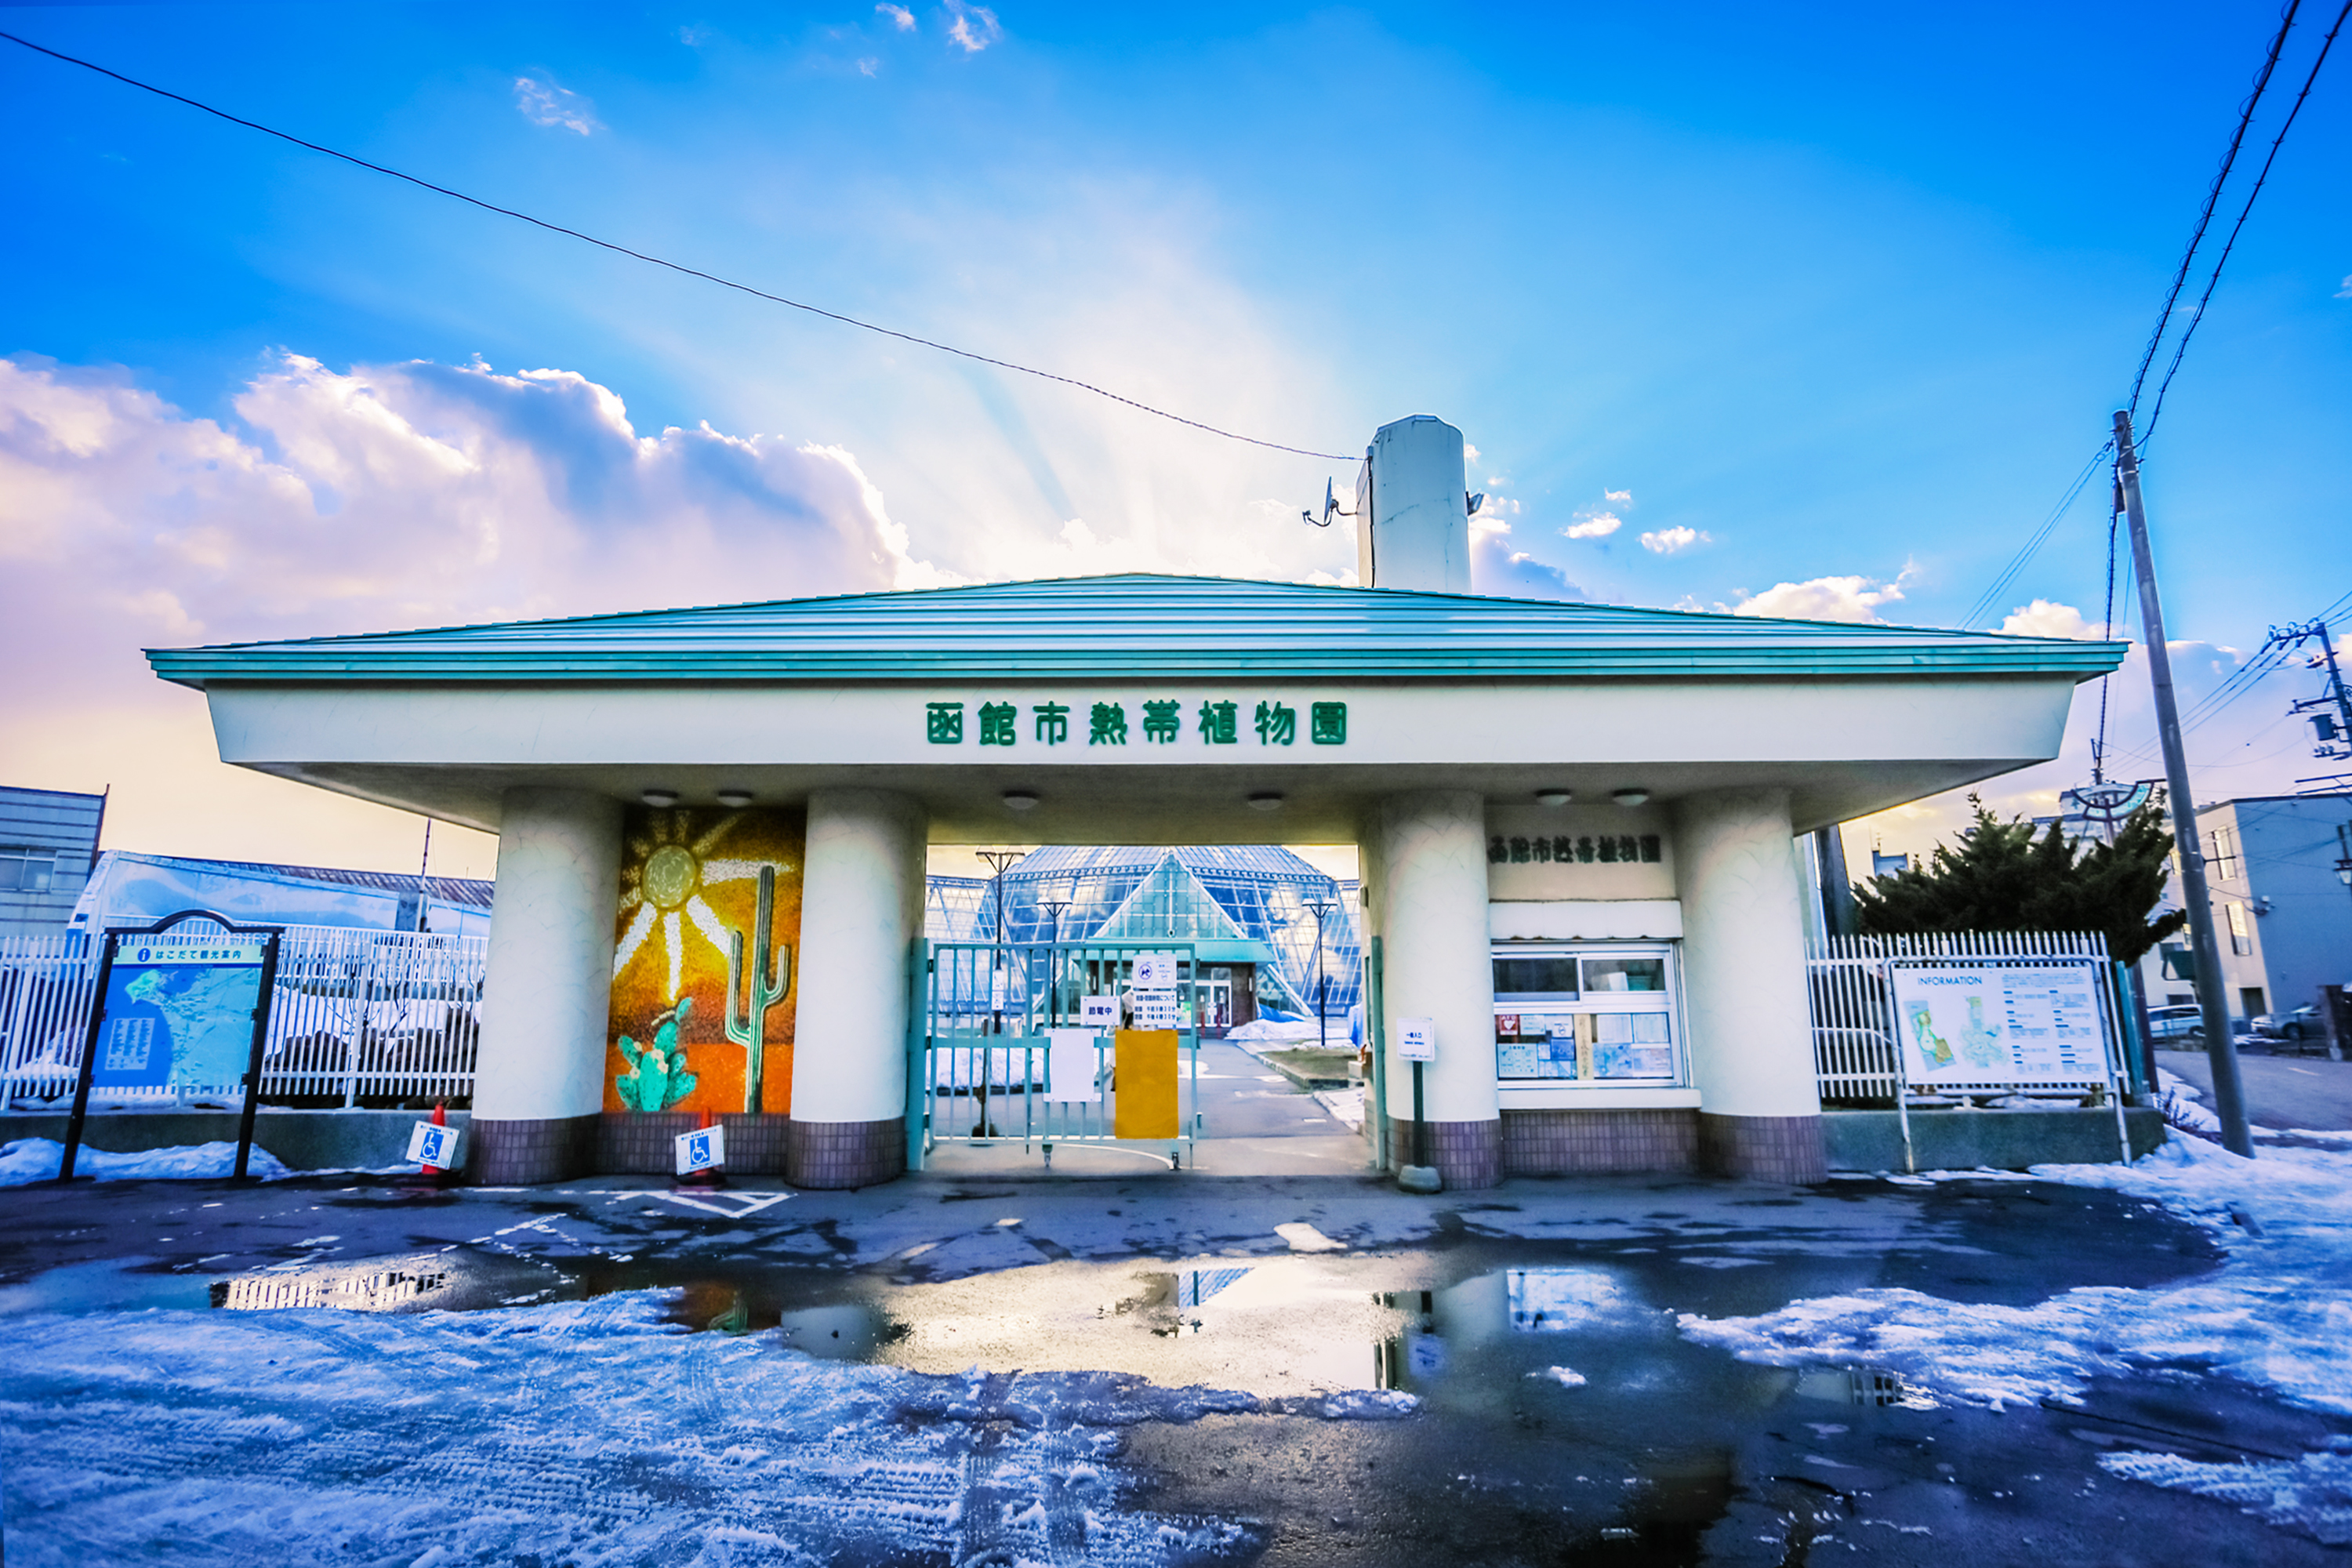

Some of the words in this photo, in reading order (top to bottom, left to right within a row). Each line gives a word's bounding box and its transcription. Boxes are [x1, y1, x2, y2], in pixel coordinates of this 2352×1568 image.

[925, 699, 1347, 746] 函館市熱帯植物園
[155, 949, 241, 960] はこだて観光案内
[1918, 976, 1982, 985] INFORMATION
